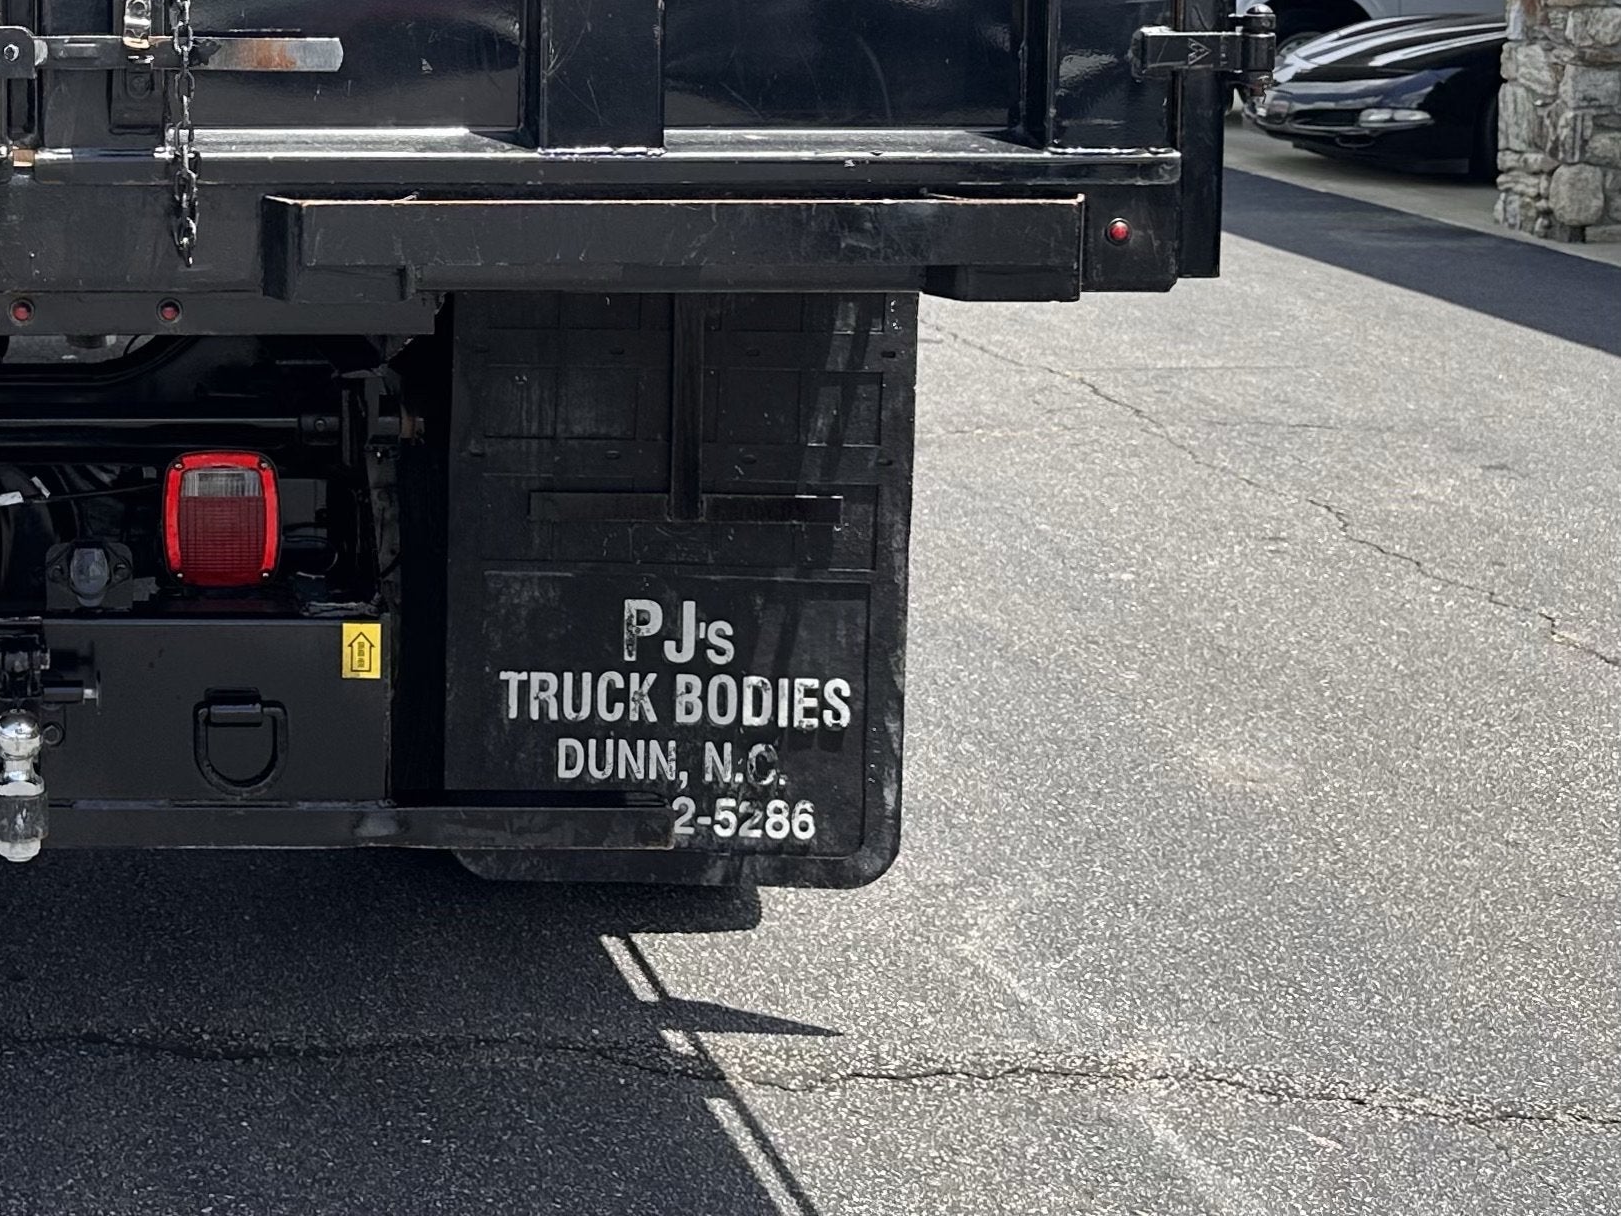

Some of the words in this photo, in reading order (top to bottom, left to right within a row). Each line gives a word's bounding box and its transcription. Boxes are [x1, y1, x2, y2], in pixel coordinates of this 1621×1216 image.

[623, 599, 735, 664] PJ's
[499, 670, 658, 723] TRUCK
[675, 673, 852, 728] BODIES
[557, 737, 689, 789] DUNN,
